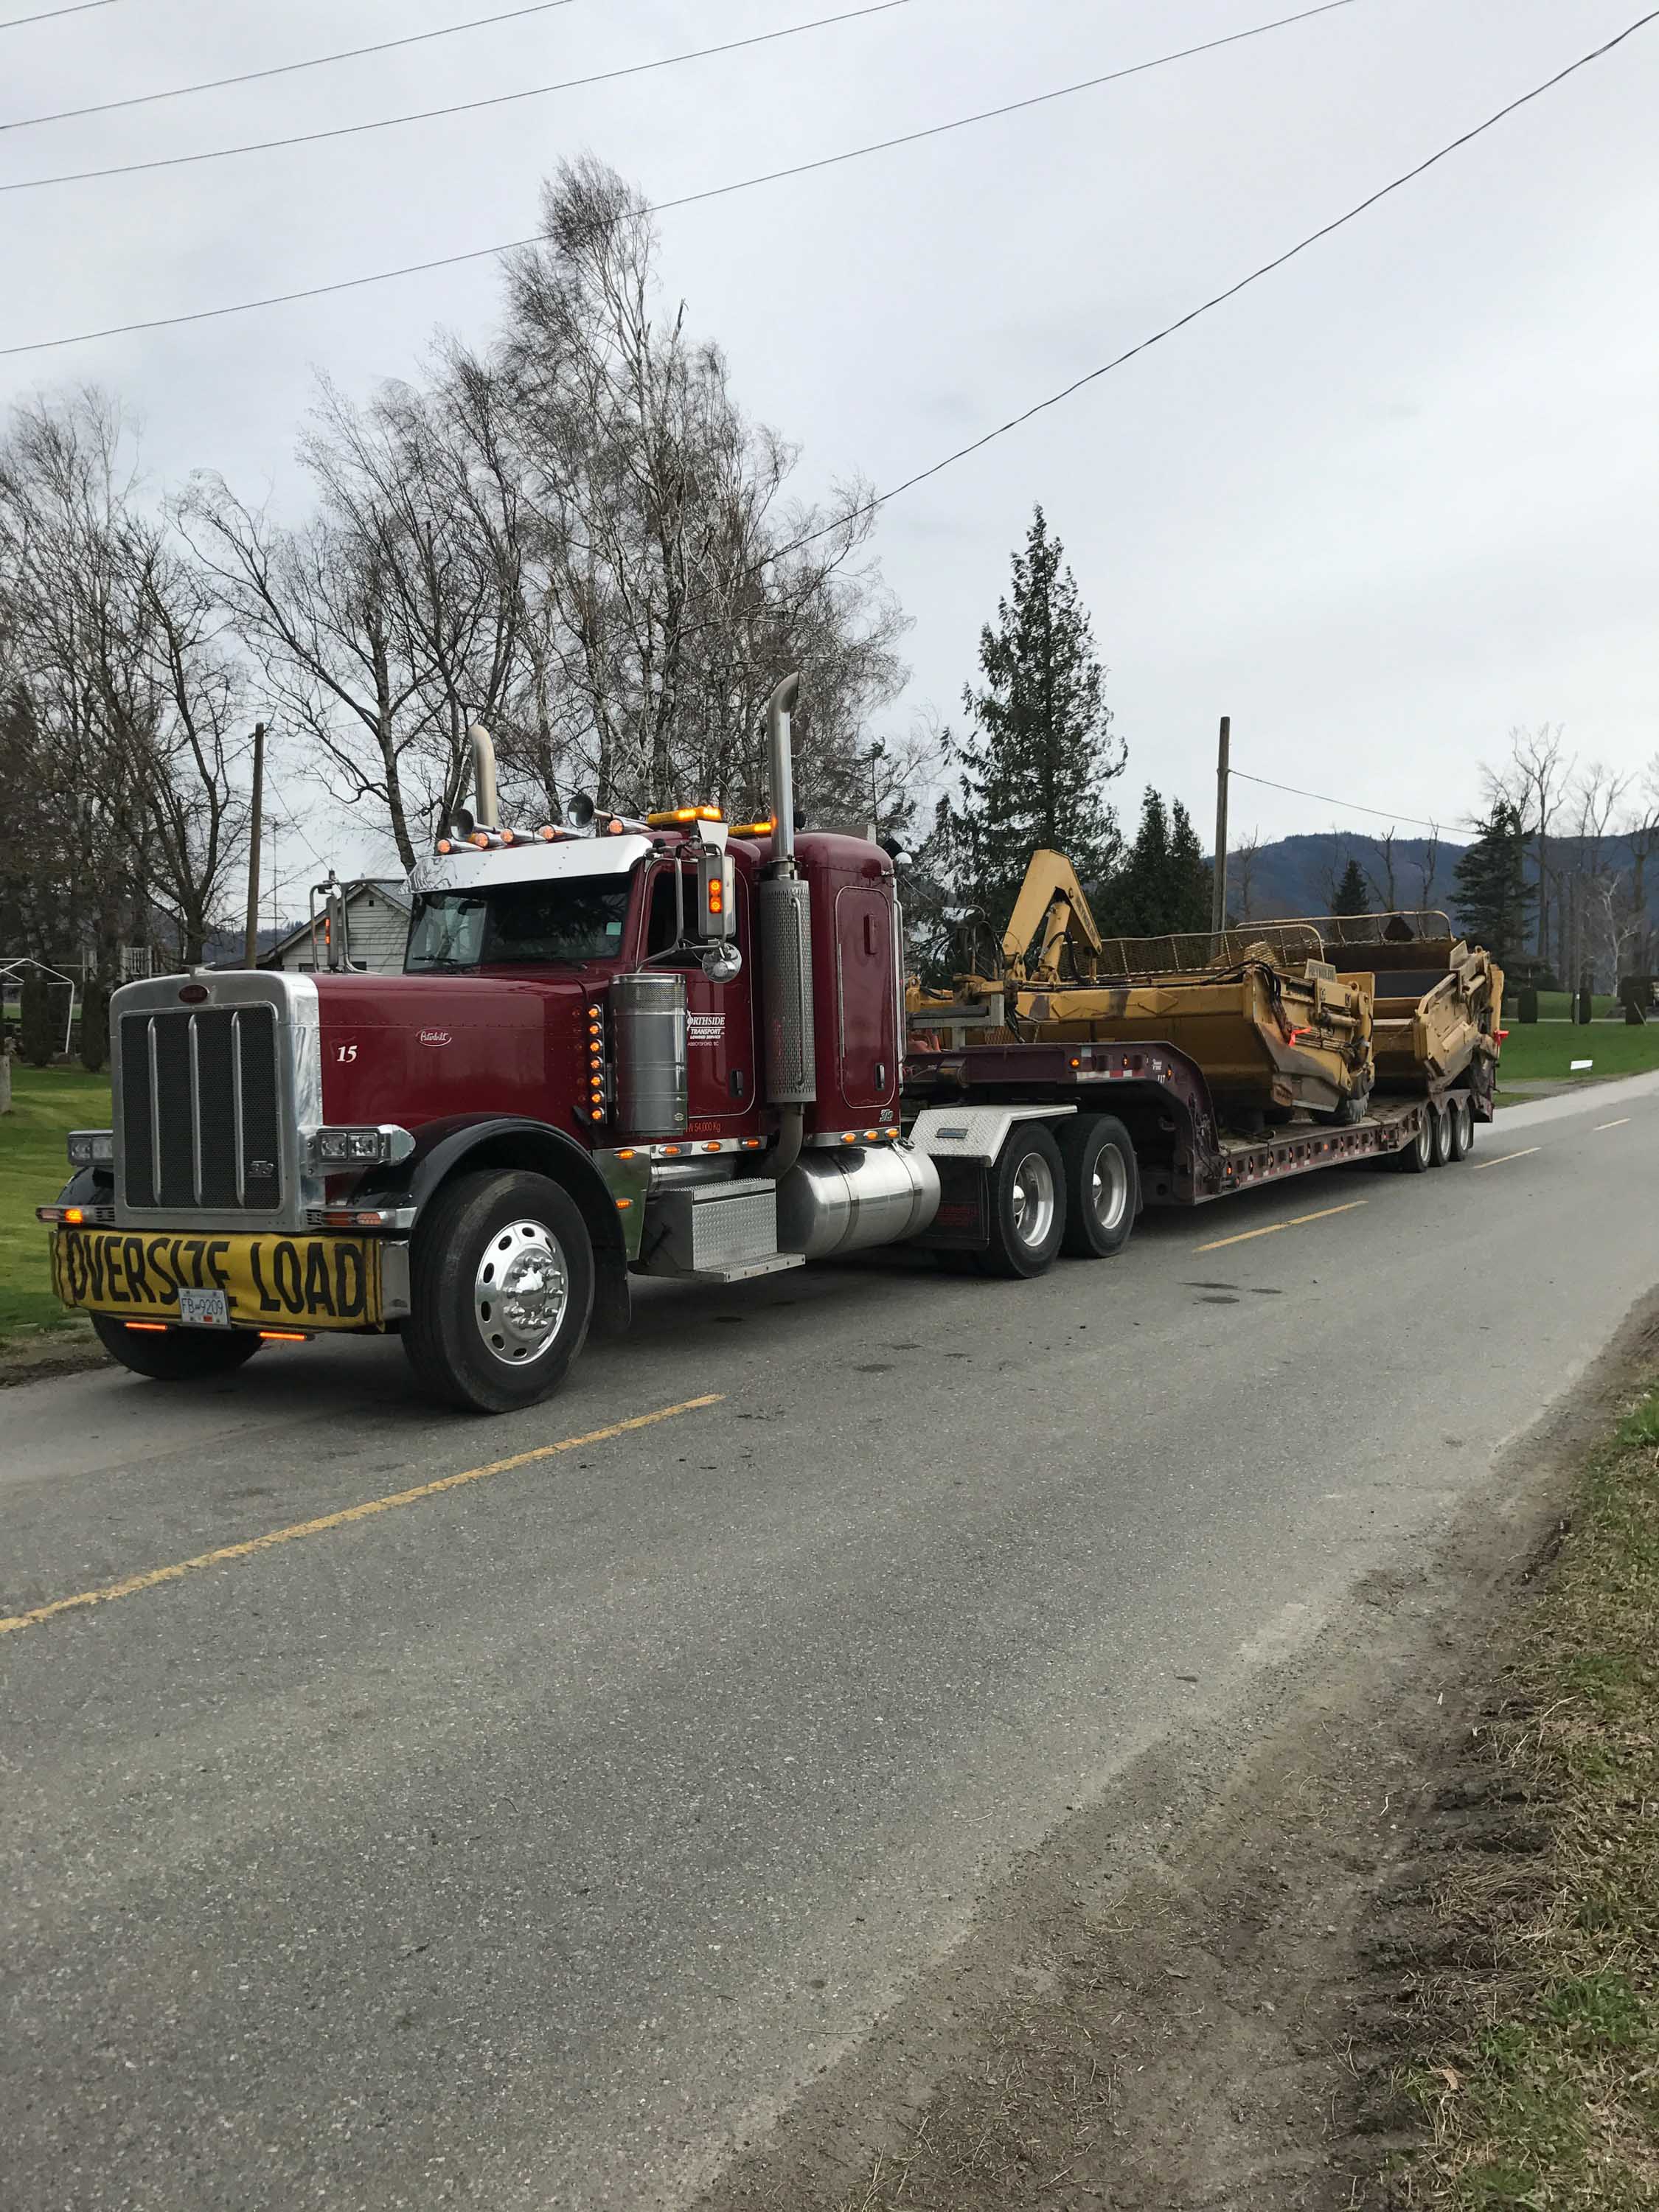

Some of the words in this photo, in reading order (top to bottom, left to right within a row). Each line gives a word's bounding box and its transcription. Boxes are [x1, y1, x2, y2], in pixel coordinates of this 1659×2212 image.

[686, 1016, 726, 1026] ORTHSIDE
[336, 1045, 358, 1062] 15
[67, 1231, 238, 1307] OVERSIZE
[250, 1241, 366, 1317] LOAD
